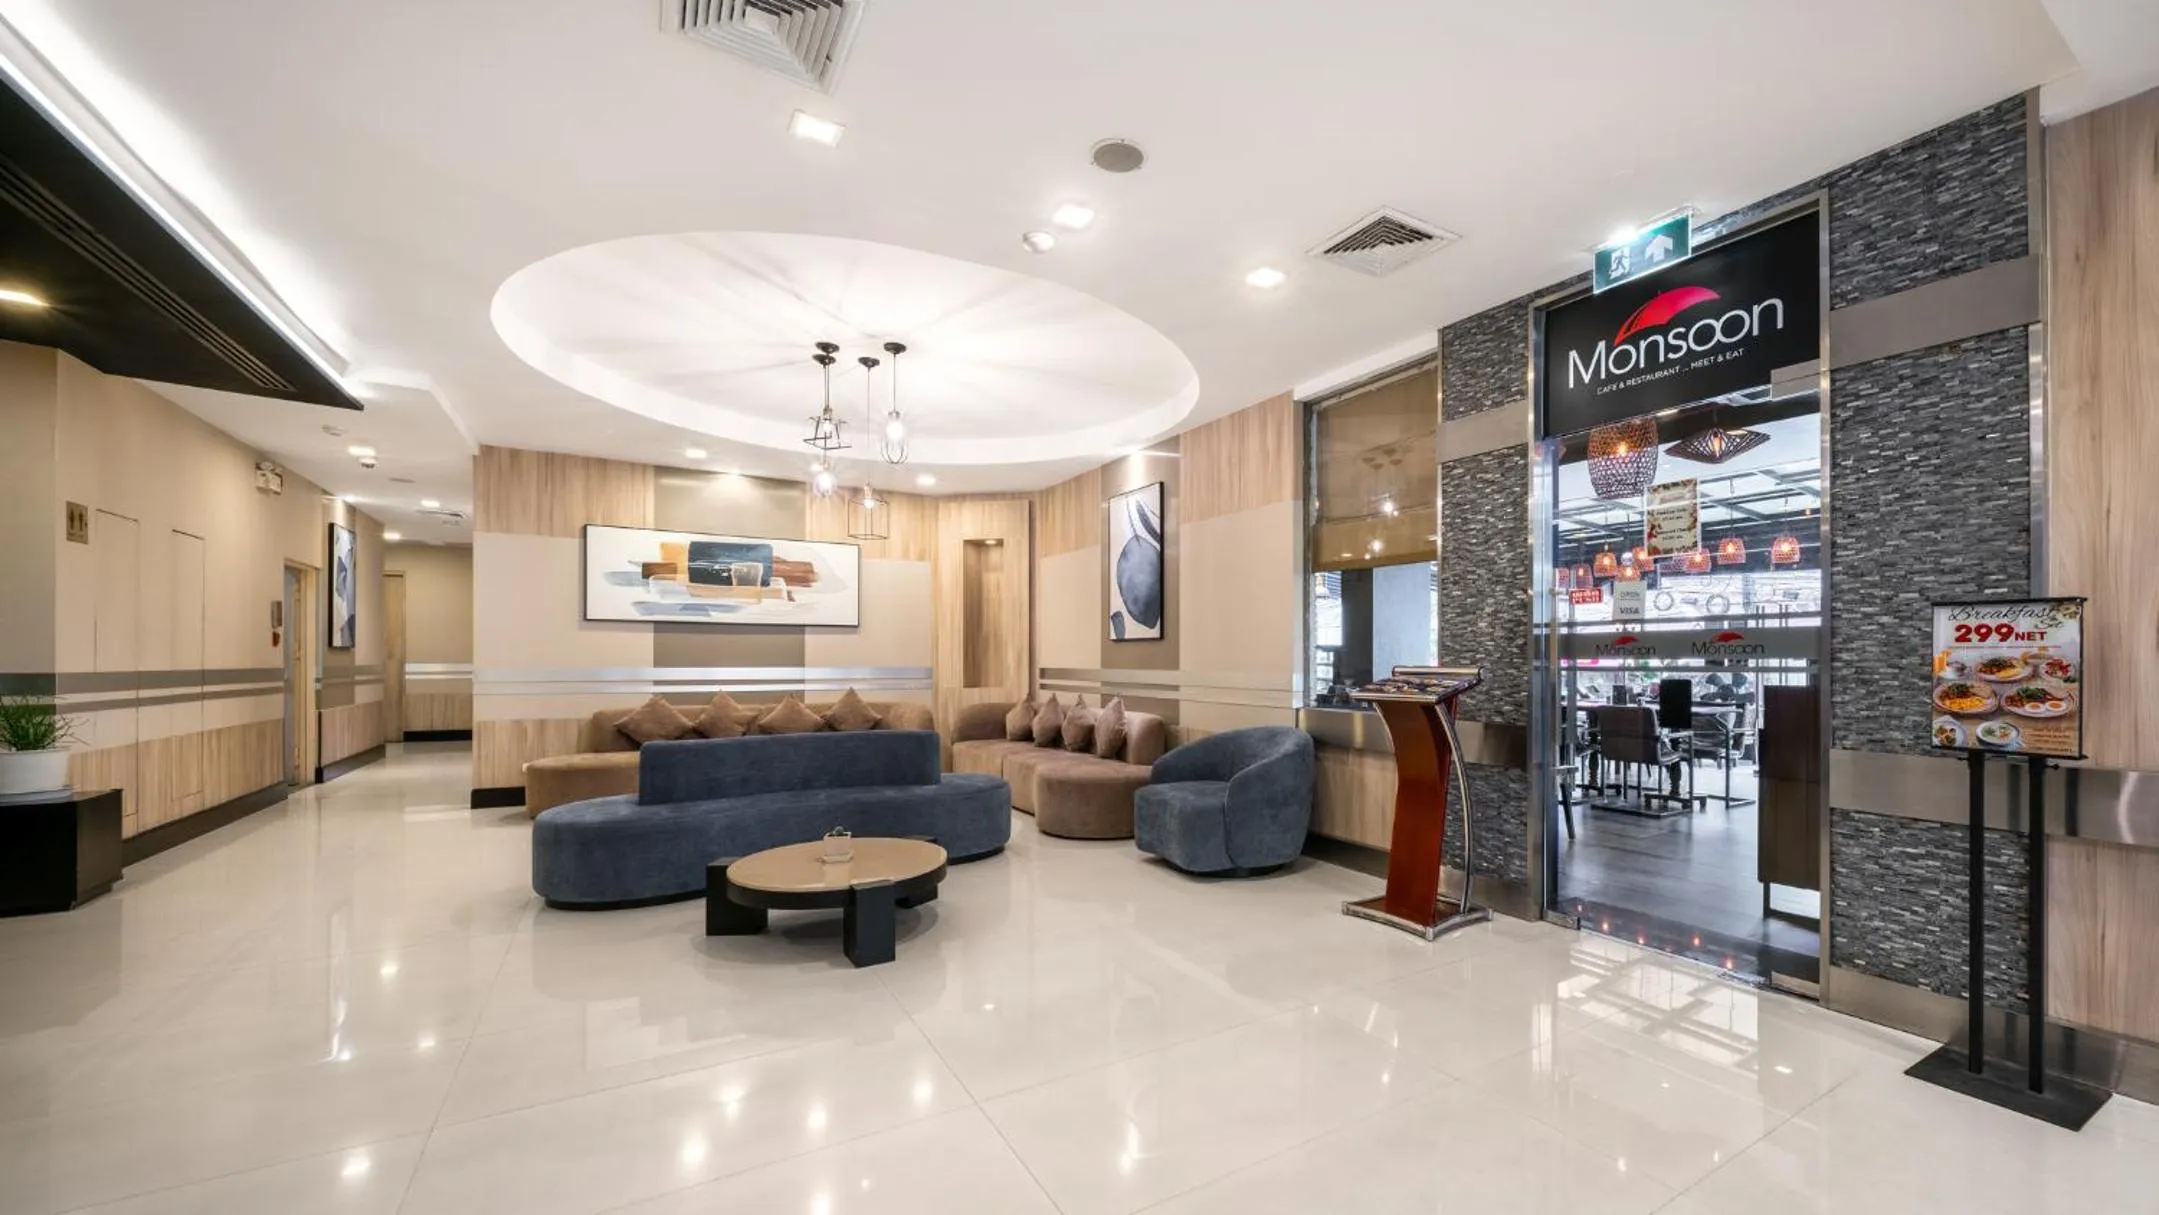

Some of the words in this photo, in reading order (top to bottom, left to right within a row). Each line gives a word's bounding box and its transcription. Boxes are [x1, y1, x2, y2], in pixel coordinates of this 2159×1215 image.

[1568, 297, 1783, 388] Monsoon
[1626, 366, 1680, 386] RESTAURANT
[1690, 356, 1715, 369] MEET
[1726, 348, 1744, 359] EAT
[1948, 604, 2054, 623] Breakfast
[1954, 623, 2015, 643] 299
[2015, 631, 2047, 642] NET
[1595, 644, 1656, 657] Monsoon
[1692, 640, 1764, 656] Monsoon
